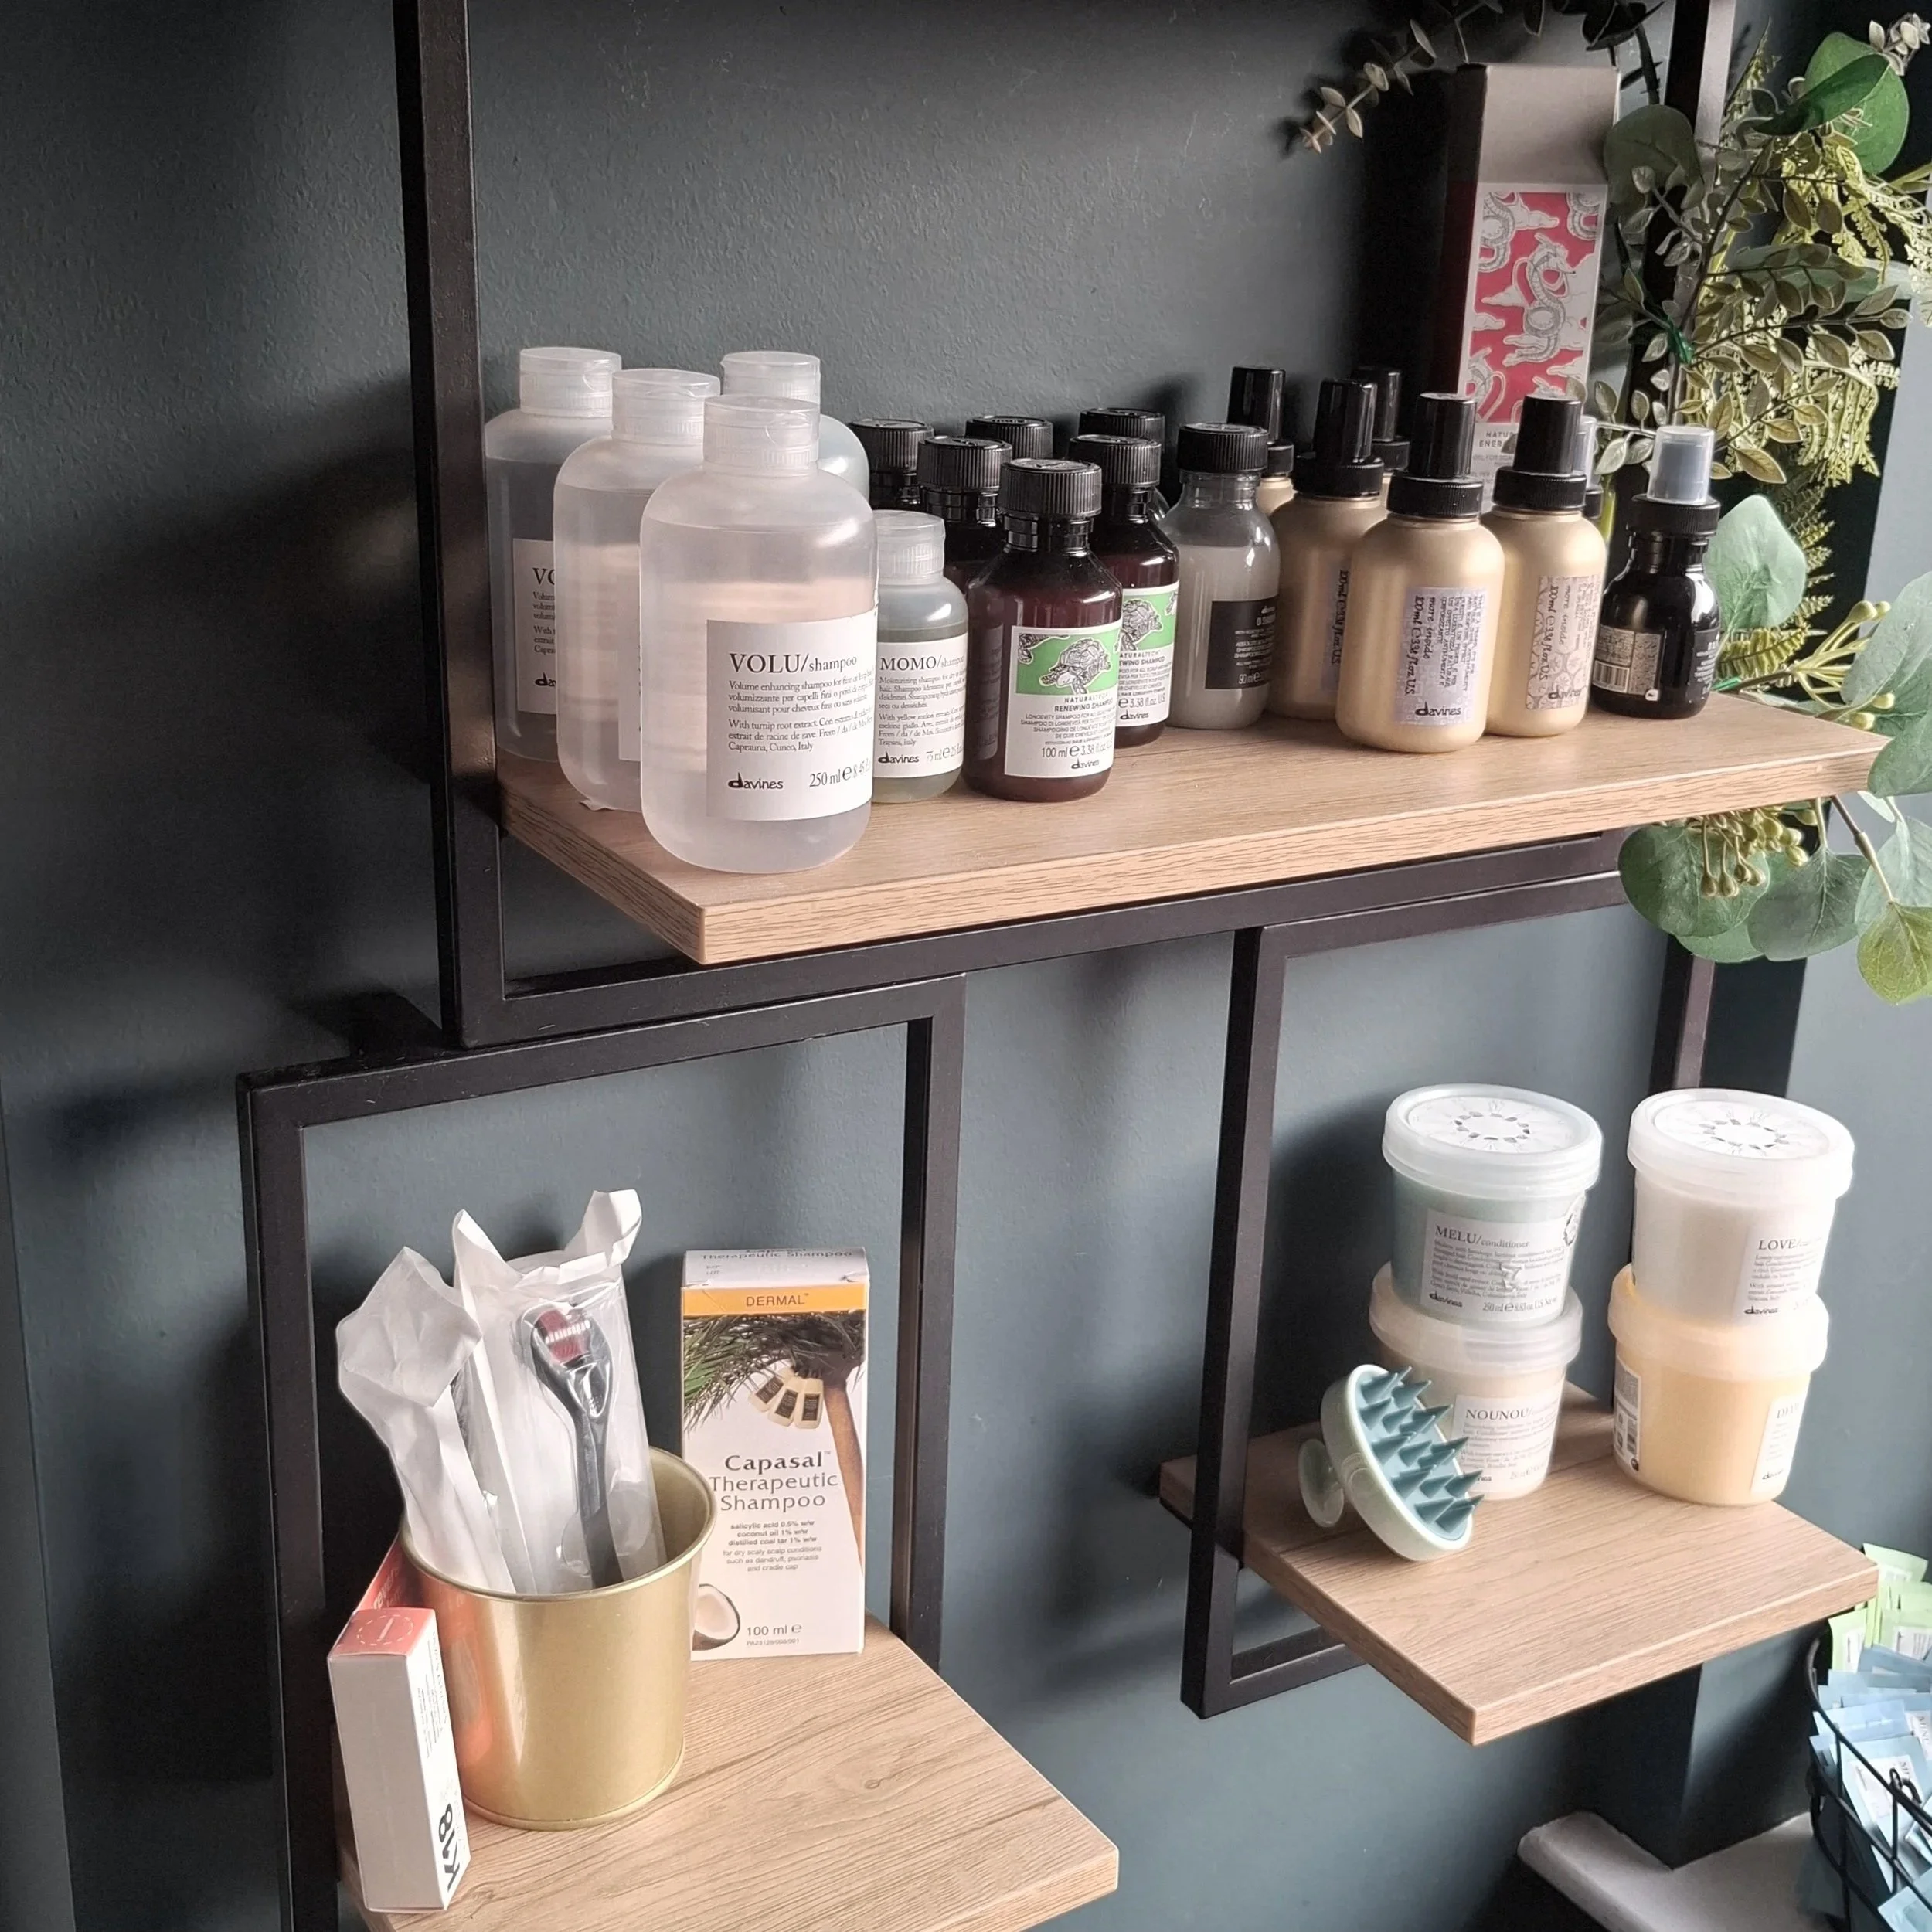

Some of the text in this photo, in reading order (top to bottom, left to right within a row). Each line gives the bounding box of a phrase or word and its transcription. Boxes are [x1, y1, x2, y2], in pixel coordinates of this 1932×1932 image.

[1558, 584, 1572, 646] more inside
[1423, 627, 1434, 660] inside
[729, 653, 857, 674] VOLU/shampoo
[1141, 656, 1165, 665] SHAMPOO
[730, 681, 759, 691] Volume
[760, 680, 800, 692] enhancing
[801, 680, 832, 691] shampoo
[893, 685, 921, 696] Shampoo
[729, 693, 780, 702] volumizzante
[782, 694, 795, 705] per
[797, 692, 818, 703] capelli
[729, 704, 770, 713] volumisant
[772, 705, 791, 716] pour
[791, 704, 820, 713] cheveux
[821, 701, 832, 709] fins
[1054, 703, 1090, 713] RENEWING
[1415, 702, 1462, 716] davines
[896, 713, 916, 722] yellow
[1120, 709, 1149, 720] davines
[729, 719, 750, 730] With
[751, 720, 774, 731] turnip
[777, 720, 792, 730] root
[819, 717, 833, 726] Con
[754, 731, 764, 740] de
[766, 731, 789, 740] racine
[791, 730, 800, 740] de
[819, 729, 836, 737] From
[729, 741, 813, 753] Caprauna, Cuneo, Italy
[1041, 747, 1056, 758] 100
[1058, 747, 1067, 757] ml
[878, 751, 920, 764] davines
[1071, 757, 1099, 770] davines
[728, 773, 784, 789] davines
[809, 771, 827, 787] 250
[830, 768, 840, 784] ml
[1435, 1225, 1530, 1248] MELU/conditioner
[701, 1251, 781, 1260] Therapeutic
[709, 1472, 838, 1495] Therapeutic
[720, 1495, 826, 1513] Shampoo
[730, 1522, 761, 1530] salicylic
[735, 1549, 746, 1557] dry
[747, 1549, 765, 1557] scaly
[767, 1547, 786, 1556] scalp
[755, 1556, 786, 1564] dandruff,
[787, 1554, 818, 1563] psoriasis
[785, 1563, 798, 1572] cap
[747, 1625, 769, 1636] 100
[773, 1625, 787, 1635] ml
[438, 1803, 461, 1892] K18
